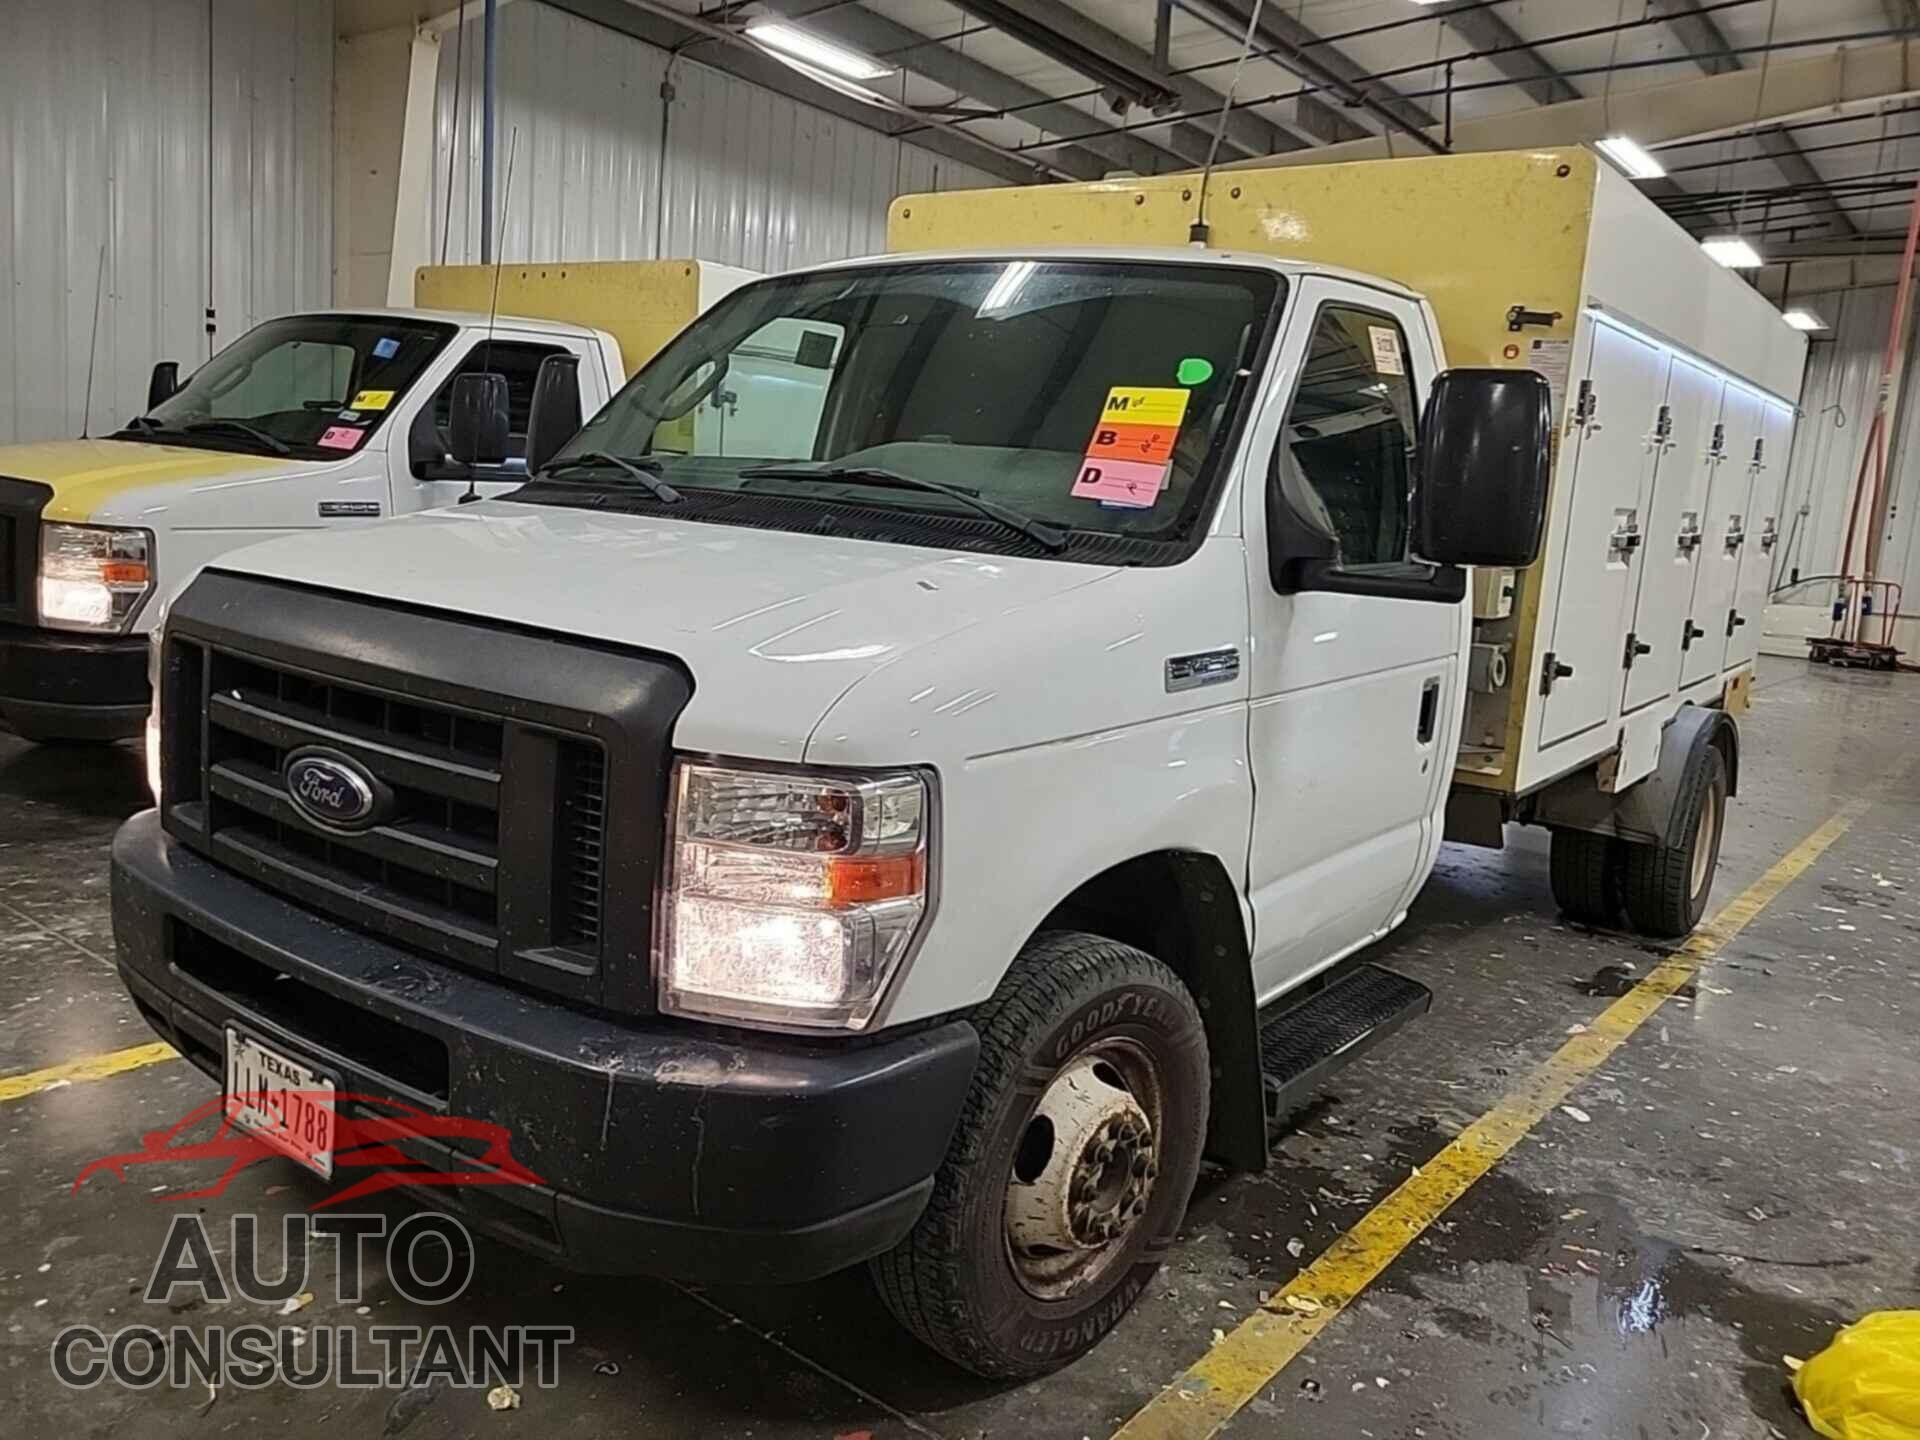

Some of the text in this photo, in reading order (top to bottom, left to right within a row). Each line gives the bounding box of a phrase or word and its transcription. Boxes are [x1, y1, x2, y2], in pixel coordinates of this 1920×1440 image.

[1107, 396, 1130, 410] M
[1096, 431, 1117, 445] B
[1081, 467, 1102, 483] D
[300, 768, 345, 808] Ford
[259, 1051, 301, 1086] TEXAS
